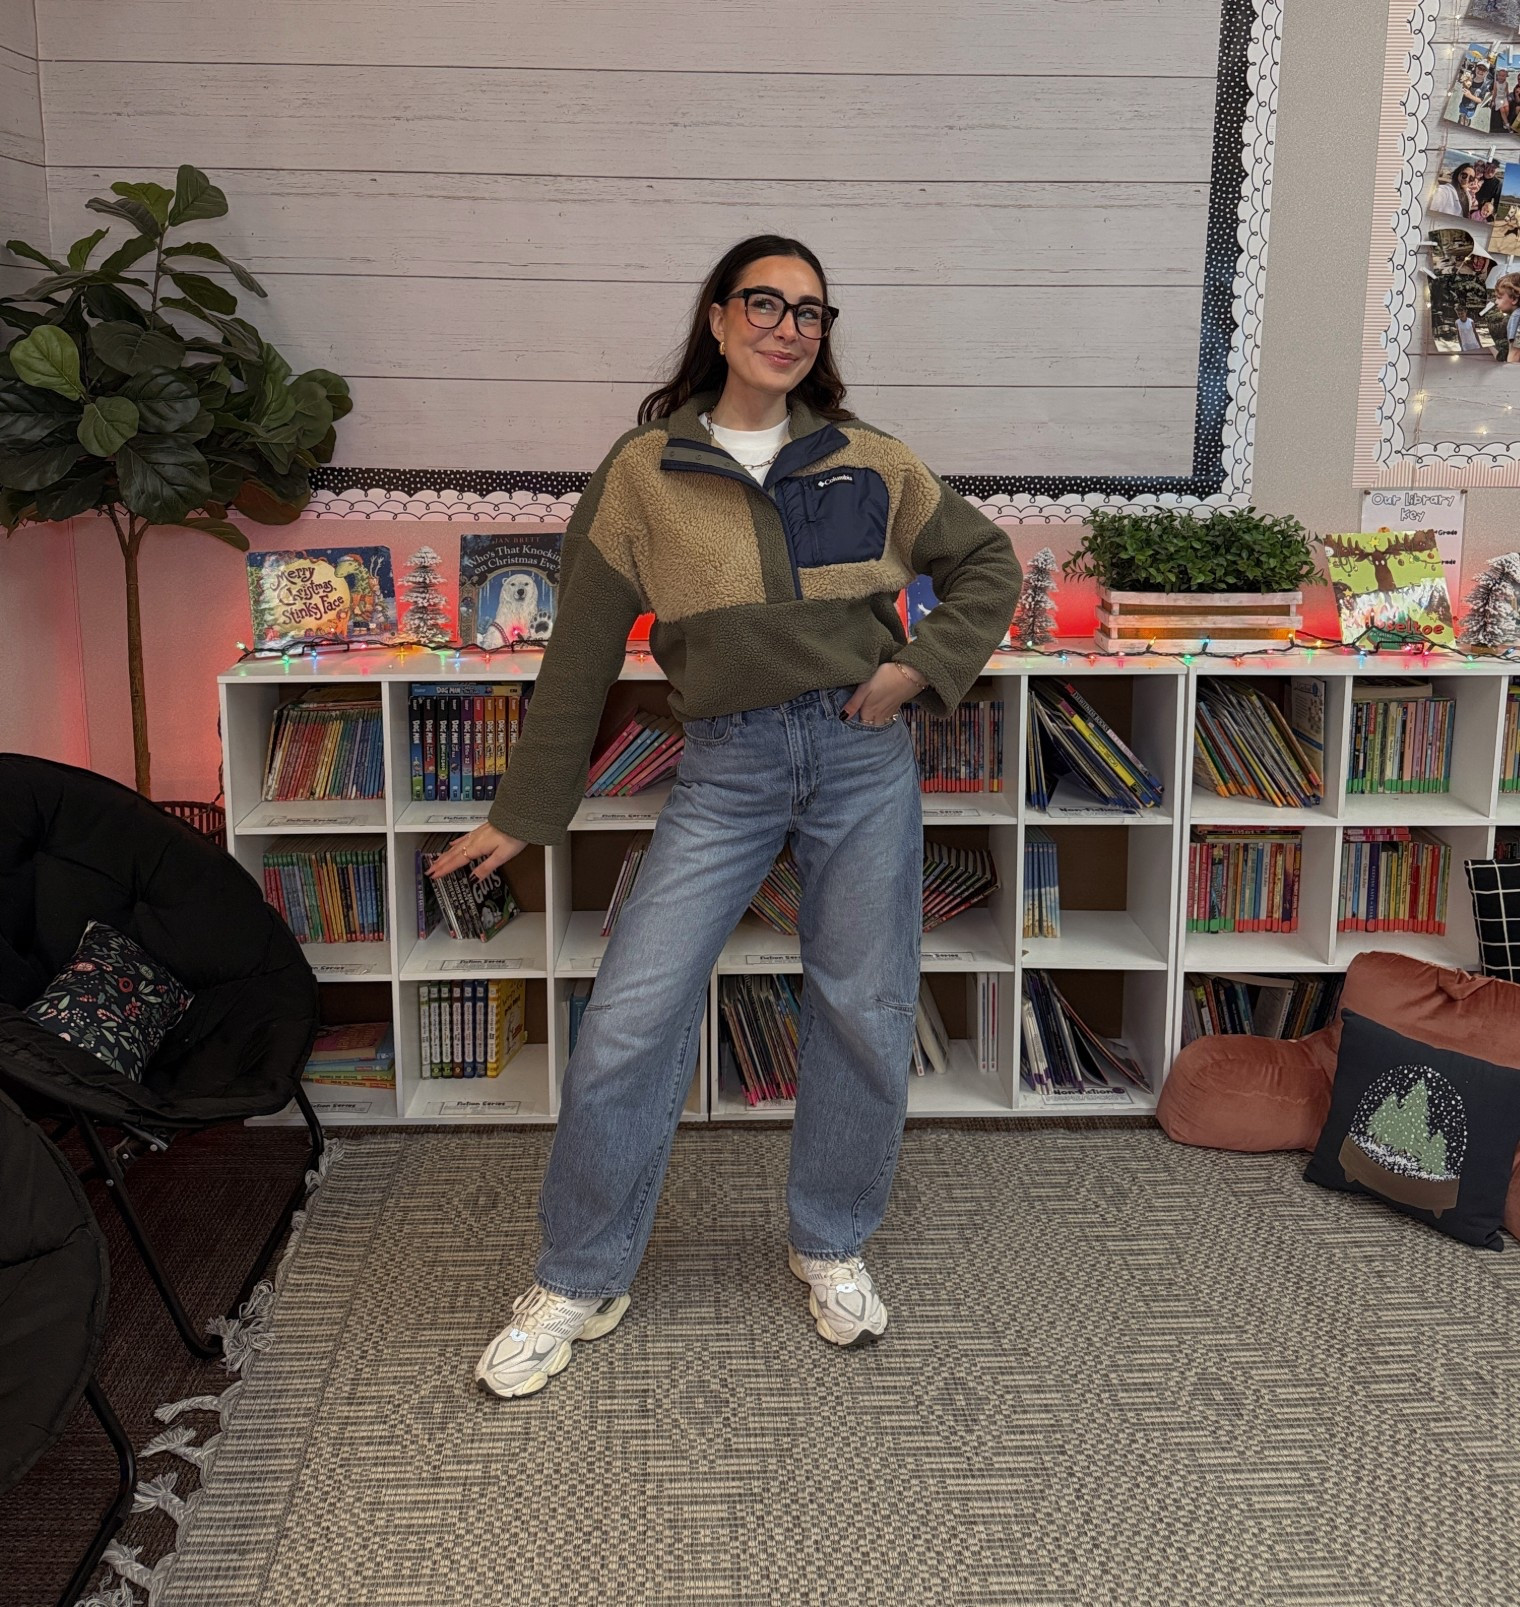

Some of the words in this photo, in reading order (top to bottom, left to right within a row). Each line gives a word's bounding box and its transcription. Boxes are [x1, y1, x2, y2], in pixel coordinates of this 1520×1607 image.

[824, 474, 853, 486] Columbia
[1372, 493, 1400, 505] Our
[1404, 492, 1455, 507] Library
[1400, 508, 1425, 522] Key
[513, 536, 540, 544] BRETT
[465, 551, 496, 569] Who's
[496, 545, 520, 556] That
[522, 545, 561, 564] Knockin
[474, 564, 488, 575] on
[487, 555, 538, 569] Christmas
[270, 567, 316, 592] Merry
[277, 580, 337, 606] Christmas,
[282, 602, 323, 625] Stinky
[319, 594, 345, 614] Face
